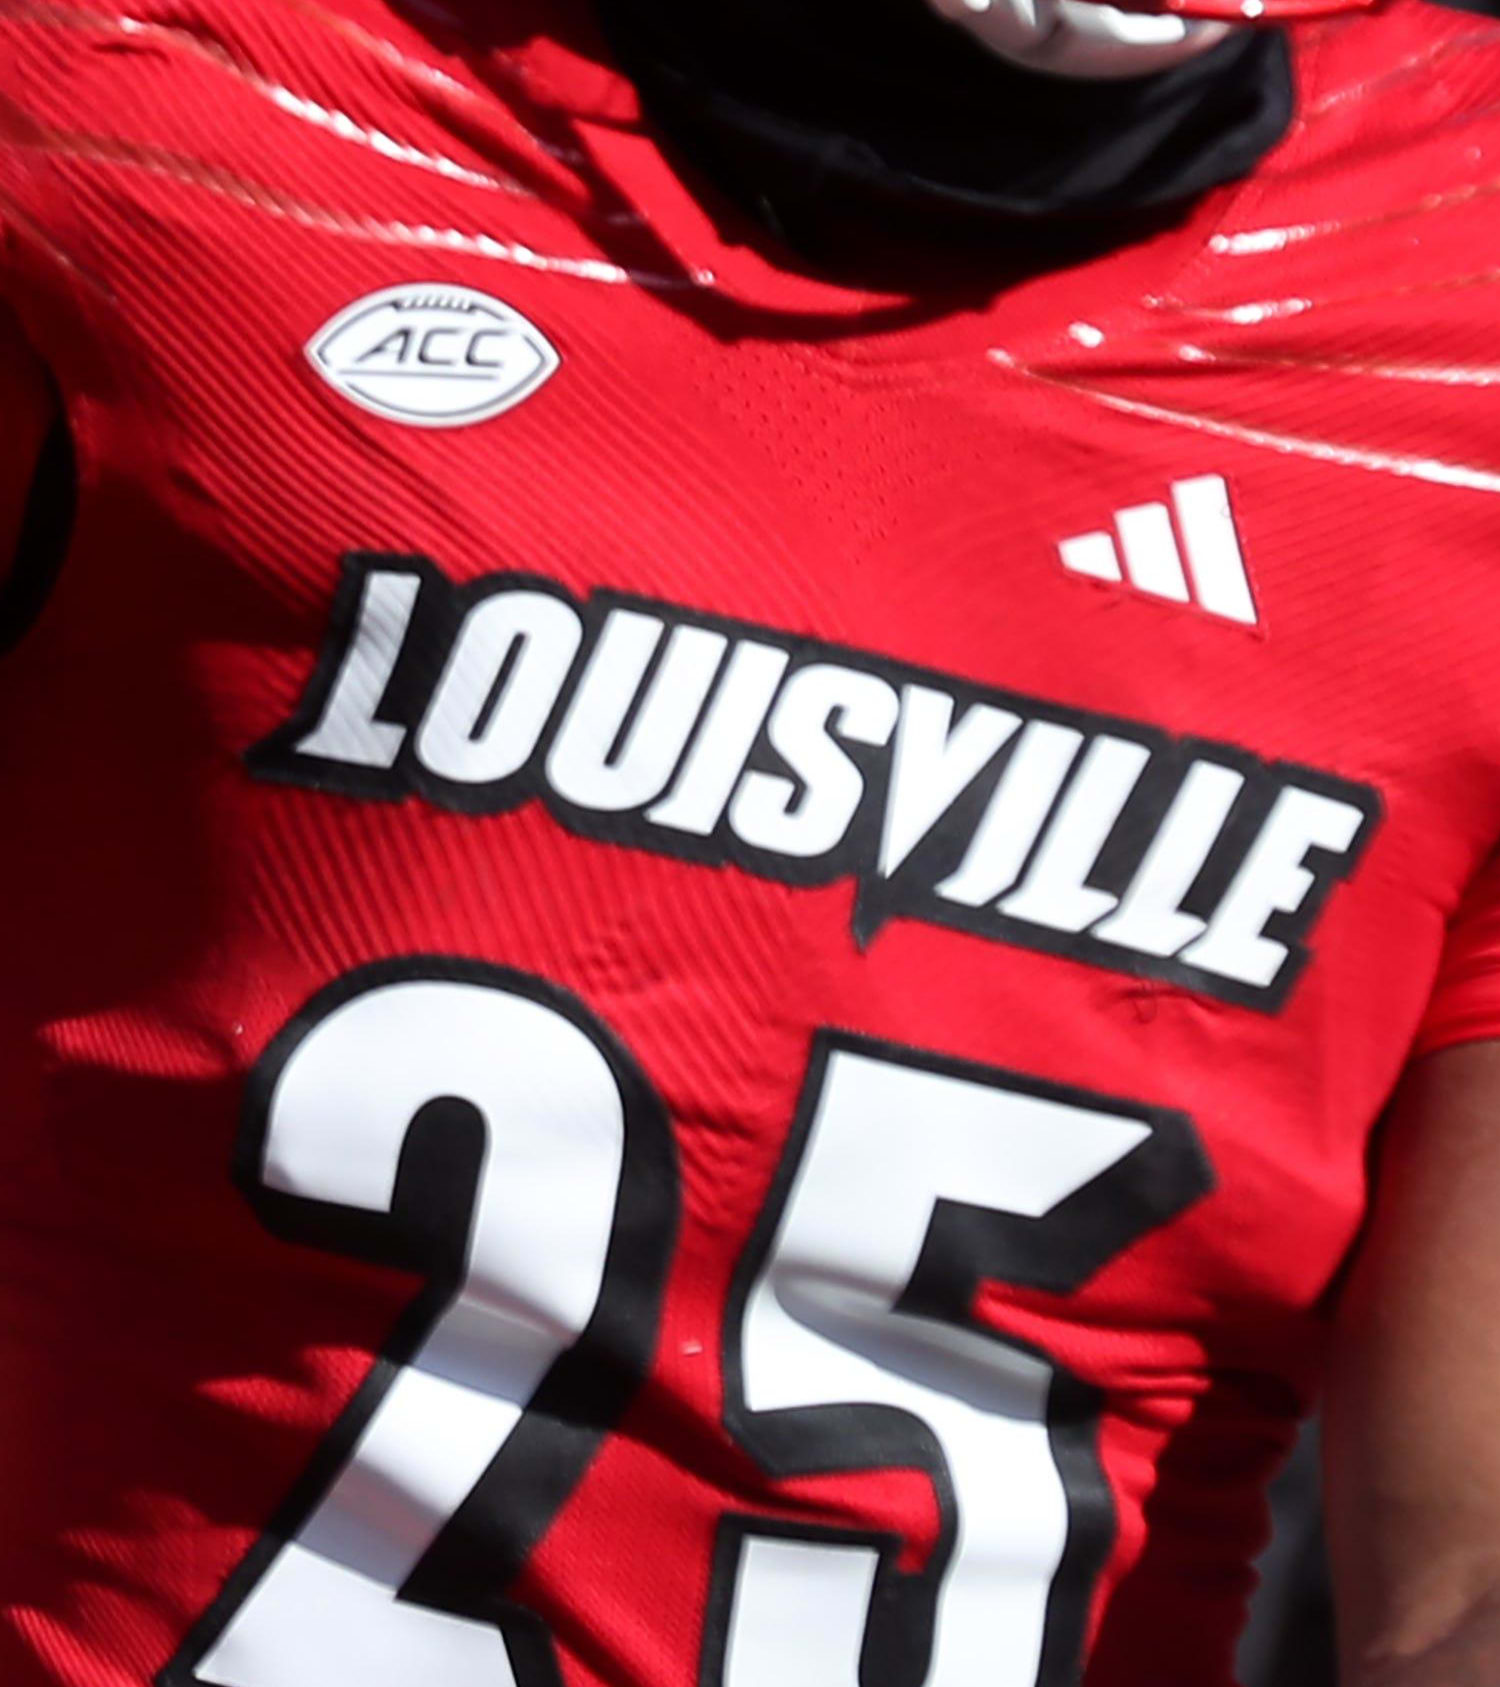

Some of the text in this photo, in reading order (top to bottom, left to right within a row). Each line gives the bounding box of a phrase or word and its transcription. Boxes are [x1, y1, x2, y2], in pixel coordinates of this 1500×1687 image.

[354, 327, 516, 369] ACC
[242, 550, 1385, 1014] LOUISVILLE
[160, 952, 1217, 1687] 25
